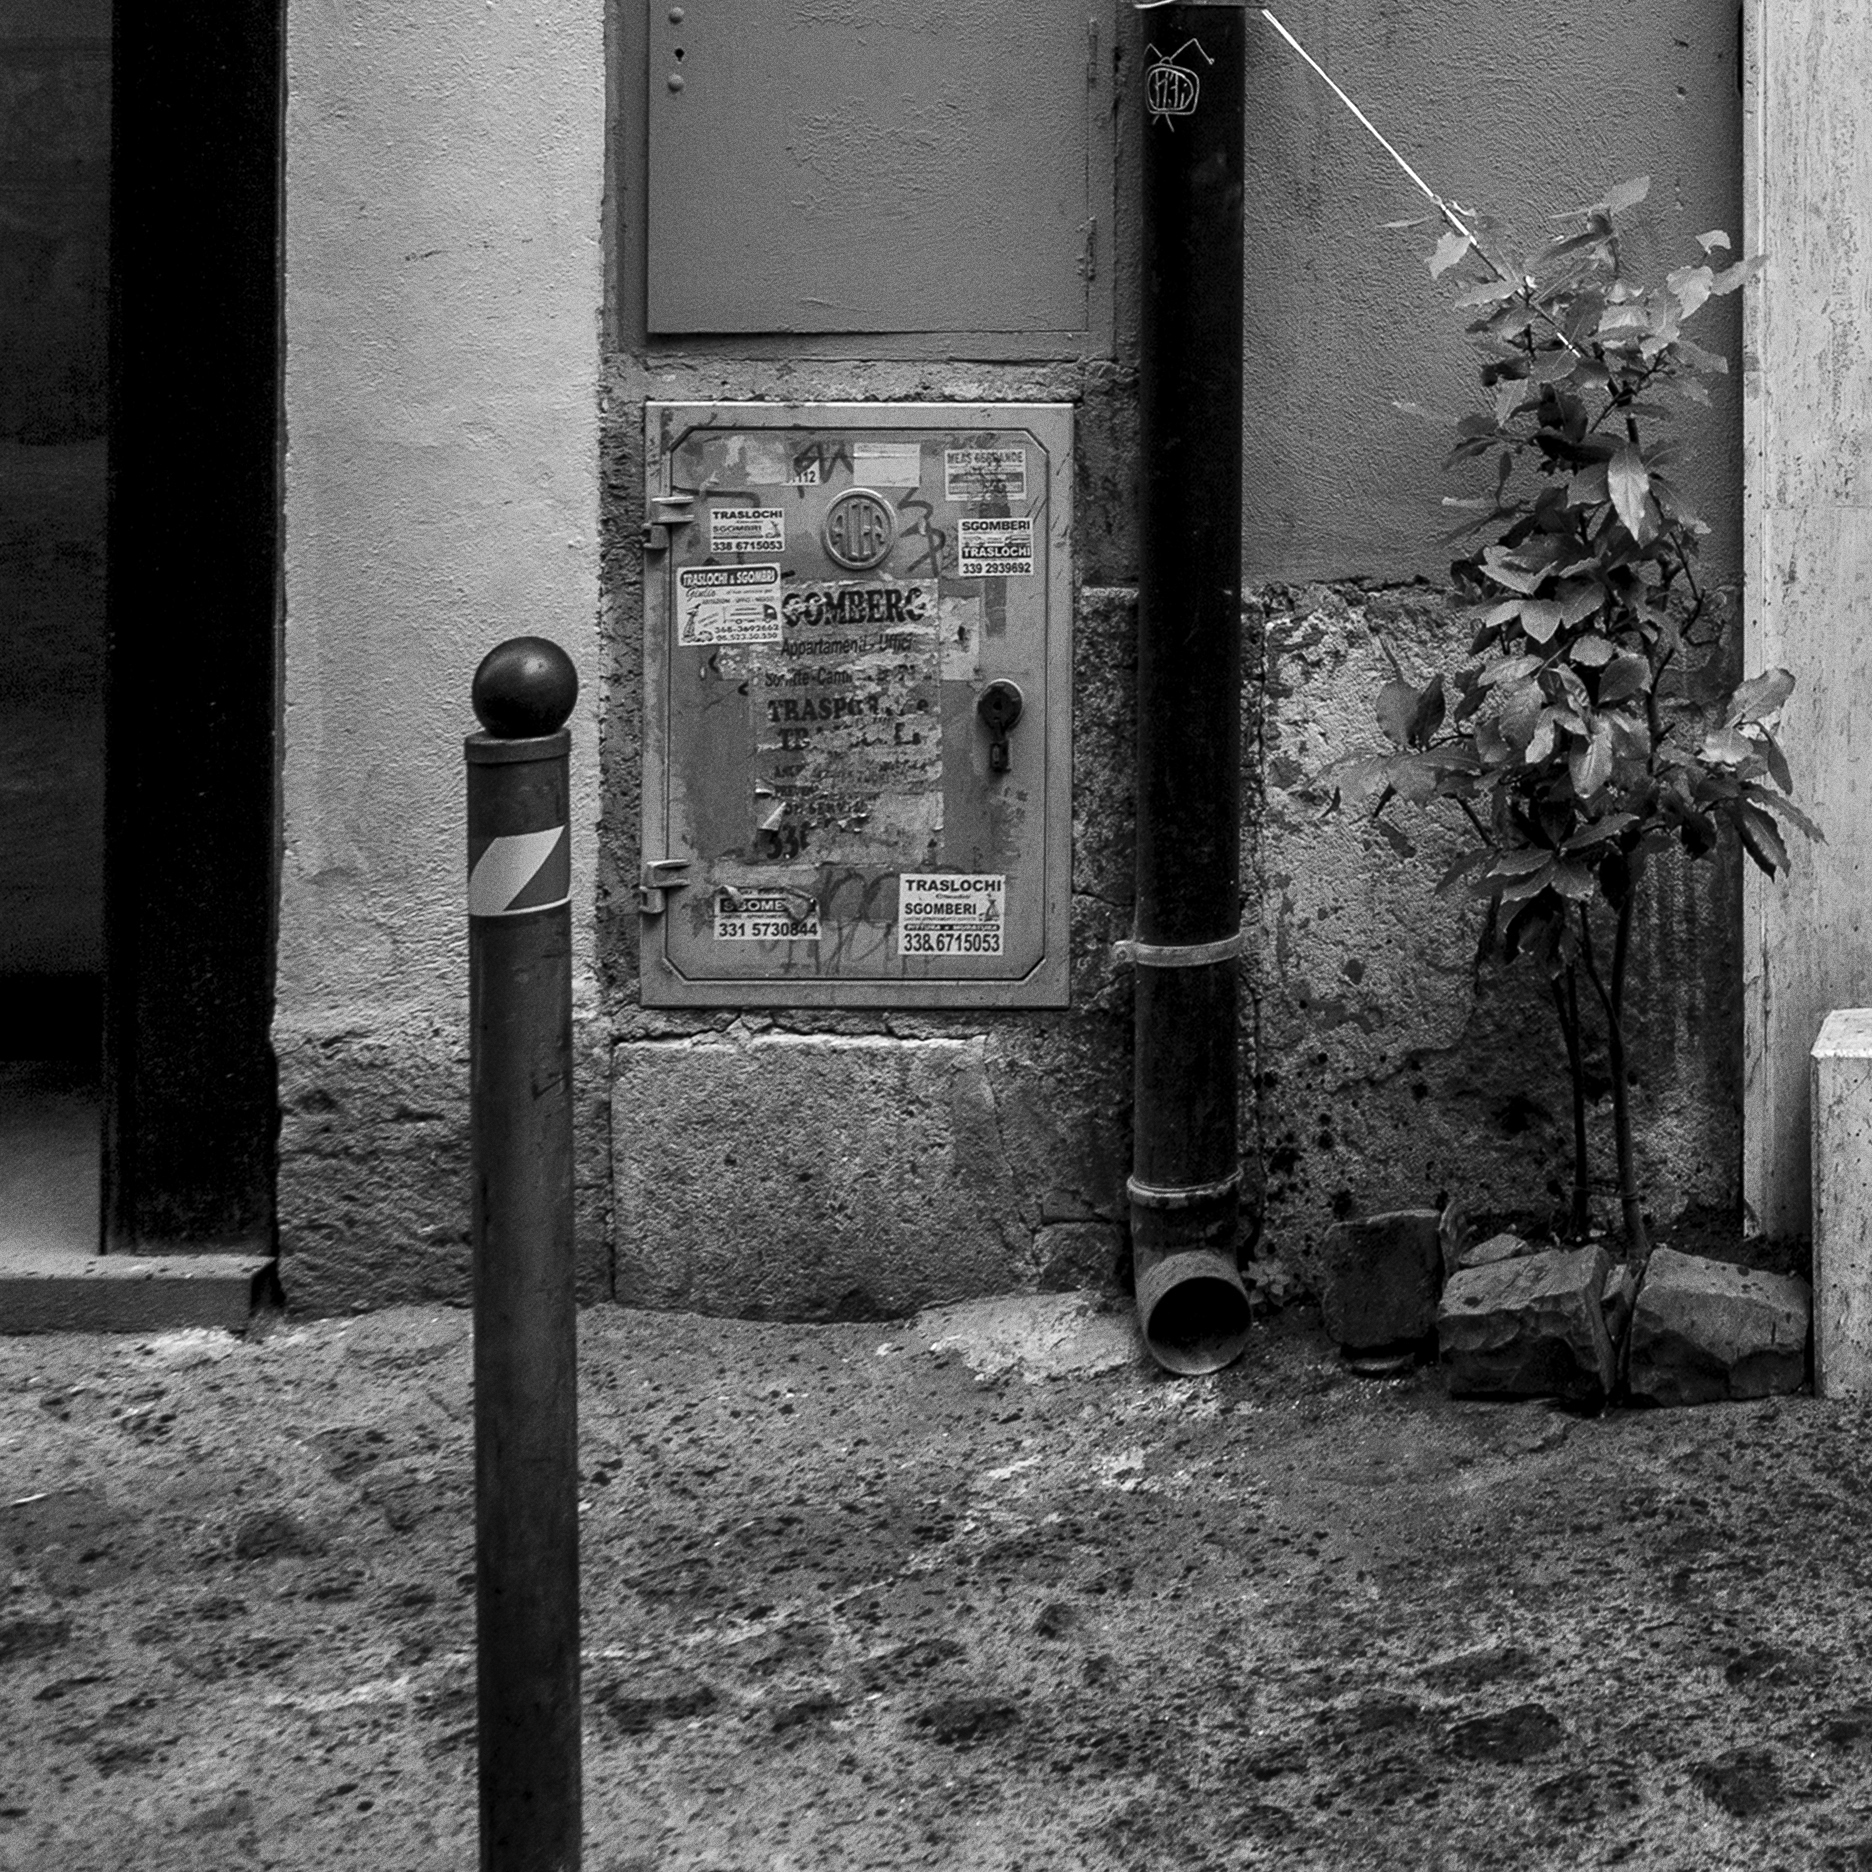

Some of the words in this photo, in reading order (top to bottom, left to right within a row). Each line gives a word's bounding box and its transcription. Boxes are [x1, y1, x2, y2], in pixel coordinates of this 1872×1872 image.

[712, 510, 783, 519] TRASLOCHI
[962, 520, 1030, 531] SGOMBERI
[963, 546, 1031, 557] TRASLOCHI
[683, 573, 728, 586] TRASLOCHI
[905, 879, 1001, 892] TRASLOCHI
[904, 902, 976, 915] SGOMBERI
[719, 922, 745, 937] 331
[936, 933, 1000, 952] 6715053
